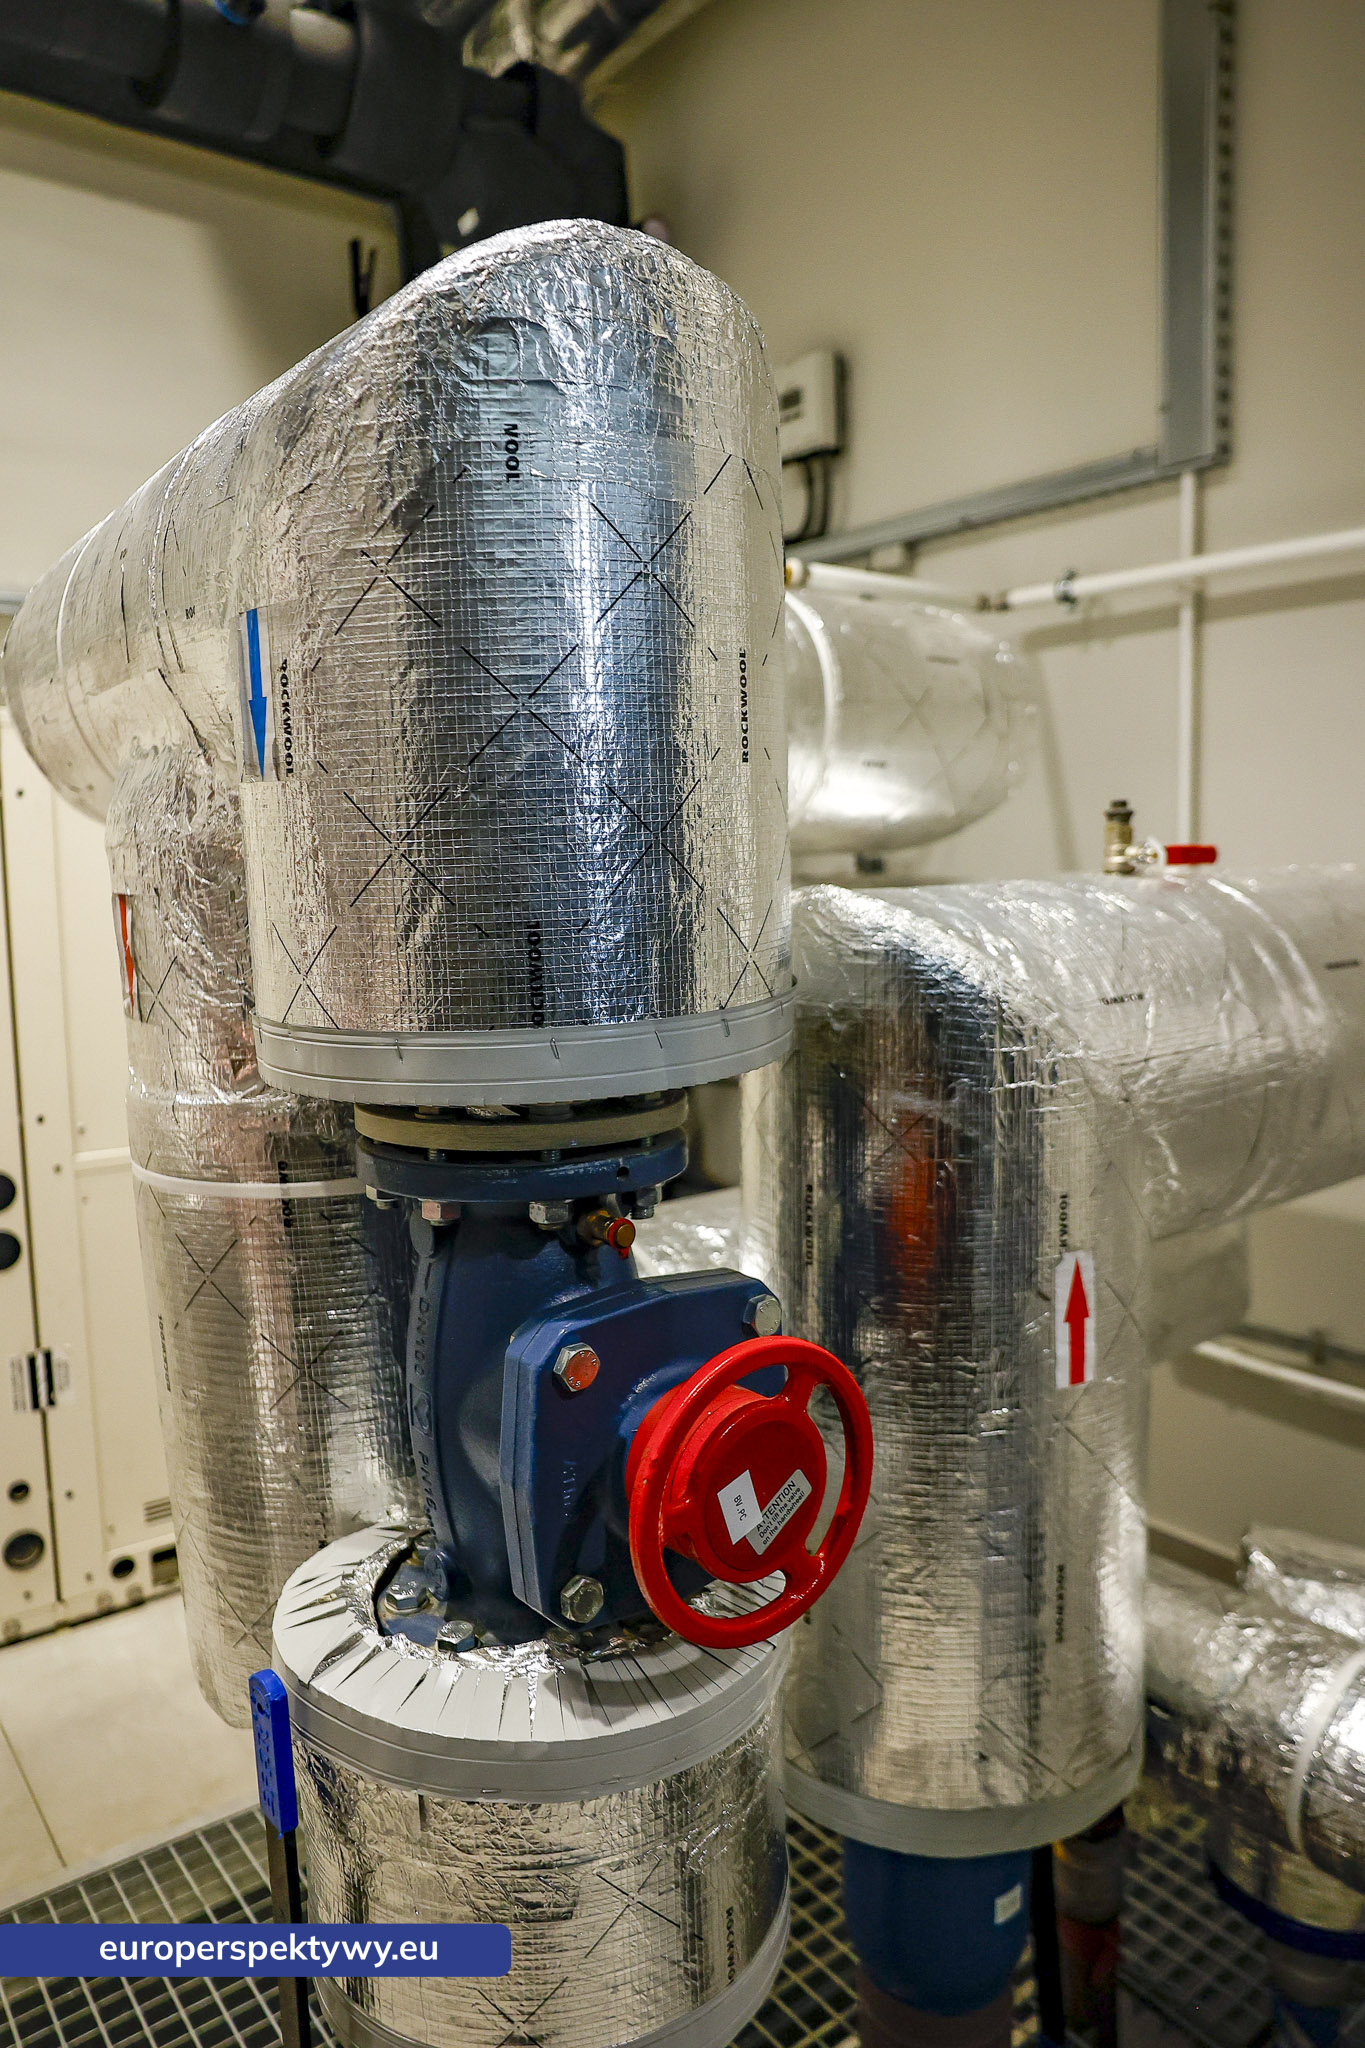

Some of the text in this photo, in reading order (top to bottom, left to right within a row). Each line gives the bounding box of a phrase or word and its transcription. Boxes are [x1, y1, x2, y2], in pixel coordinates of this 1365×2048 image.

[279, 659, 294, 777] ROCKWOOL
[738, 648, 749, 763] ROCKWOOL
[527, 920, 545, 1028] OCKWOOL
[763, 1536, 770, 1545] on
[769, 1525, 778, 1536] the
[778, 1503, 788, 1514] the
